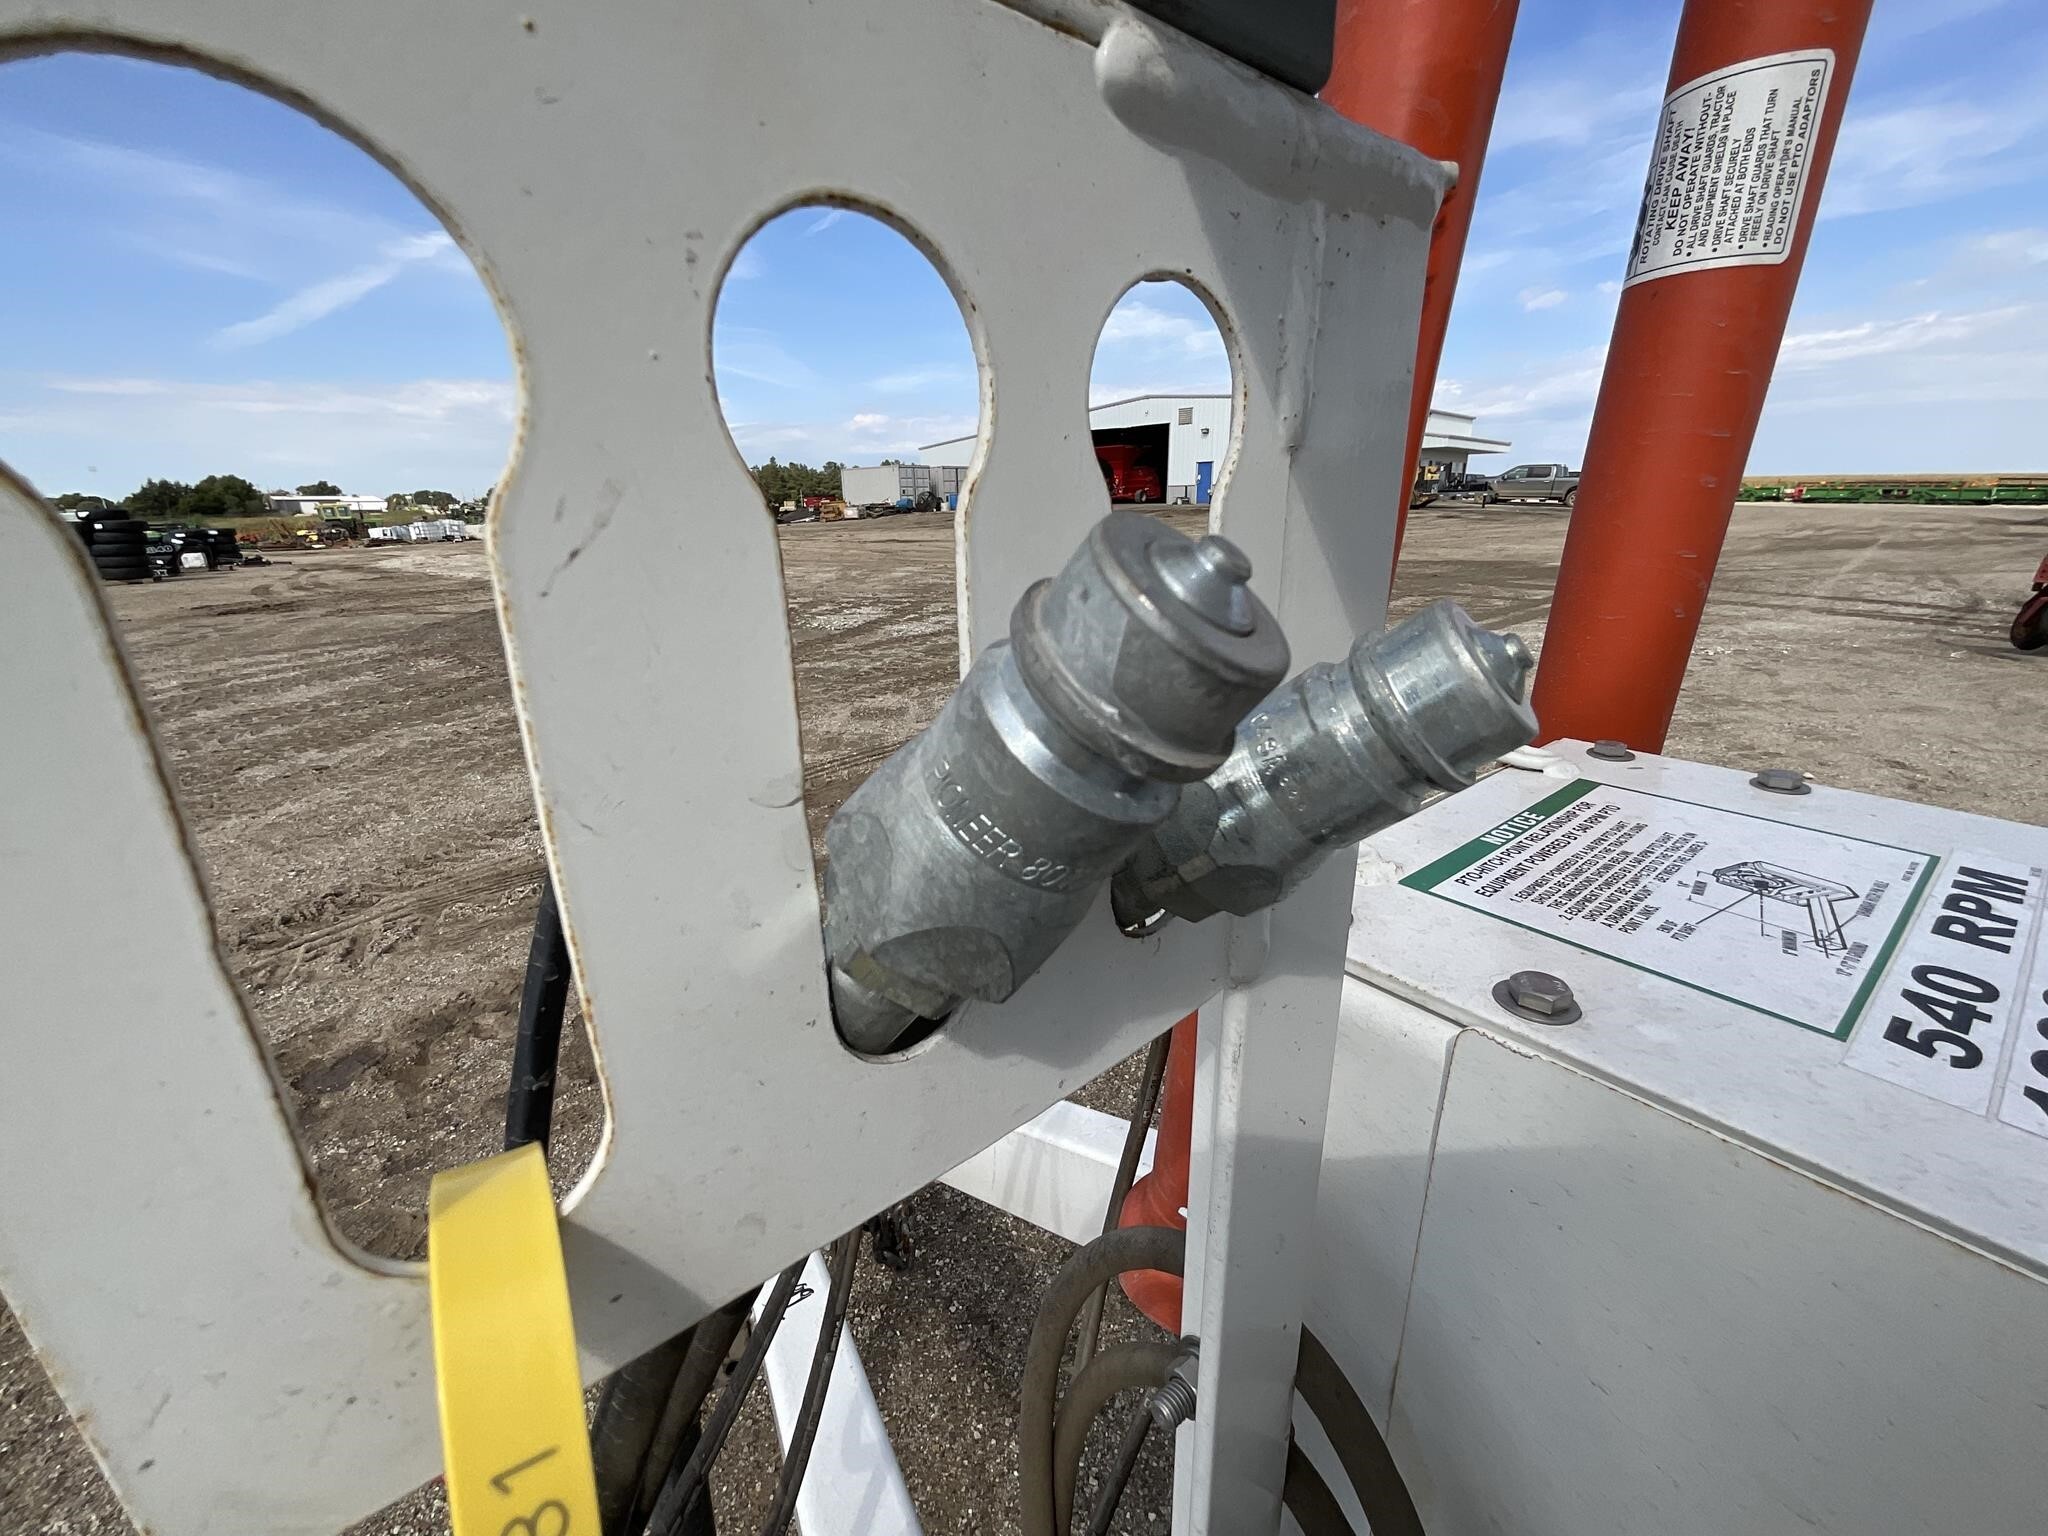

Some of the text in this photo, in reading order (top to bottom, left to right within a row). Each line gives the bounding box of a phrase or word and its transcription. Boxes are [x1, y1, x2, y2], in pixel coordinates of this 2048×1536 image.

[1710, 85, 1726, 130] TRACTOR
[1773, 69, 1820, 244] DO NOT USE PTO ADAPTORS
[1640, 110, 1676, 263] ROTATING DRIVE SHAFT
[1652, 120, 1683, 246] CONTACT CAN CAUSE DEATH
[1665, 128, 1695, 230] KEEP AWAY!
[1673, 93, 1712, 256] DO NOT OPERATE WITHOUT-
[1690, 204, 1703, 231] DRIVE
[1695, 175, 1708, 203] SHAFT
[1697, 91, 1736, 247] AND EQUIPMENT SHIELDS IN PLACE
[1712, 139, 1741, 246] DRIVE SHAFT SECURELY
[1724, 127, 1756, 243] ATTACHED AT BOTH ENDS
[1738, 89, 1778, 242] DRIVE SHAFT GUARDS THAT TURN
[1749, 130, 1781, 241] FREELY ON DRIVE SHAFT
[1763, 201, 1779, 241] READING
[1786, 97, 1802, 136] MANUAL
[1686, 232, 1697, 249] ALL
[1455, 802, 1596, 886] PTO-HITCH POINT RELATIONSHIP FOR
[1475, 805, 1620, 897] EQUIPMENT POWERED BY 540 RPM PTO
[1481, 812, 1544, 844] NOTICE
[1883, 866, 2029, 1069] 540 RPM
